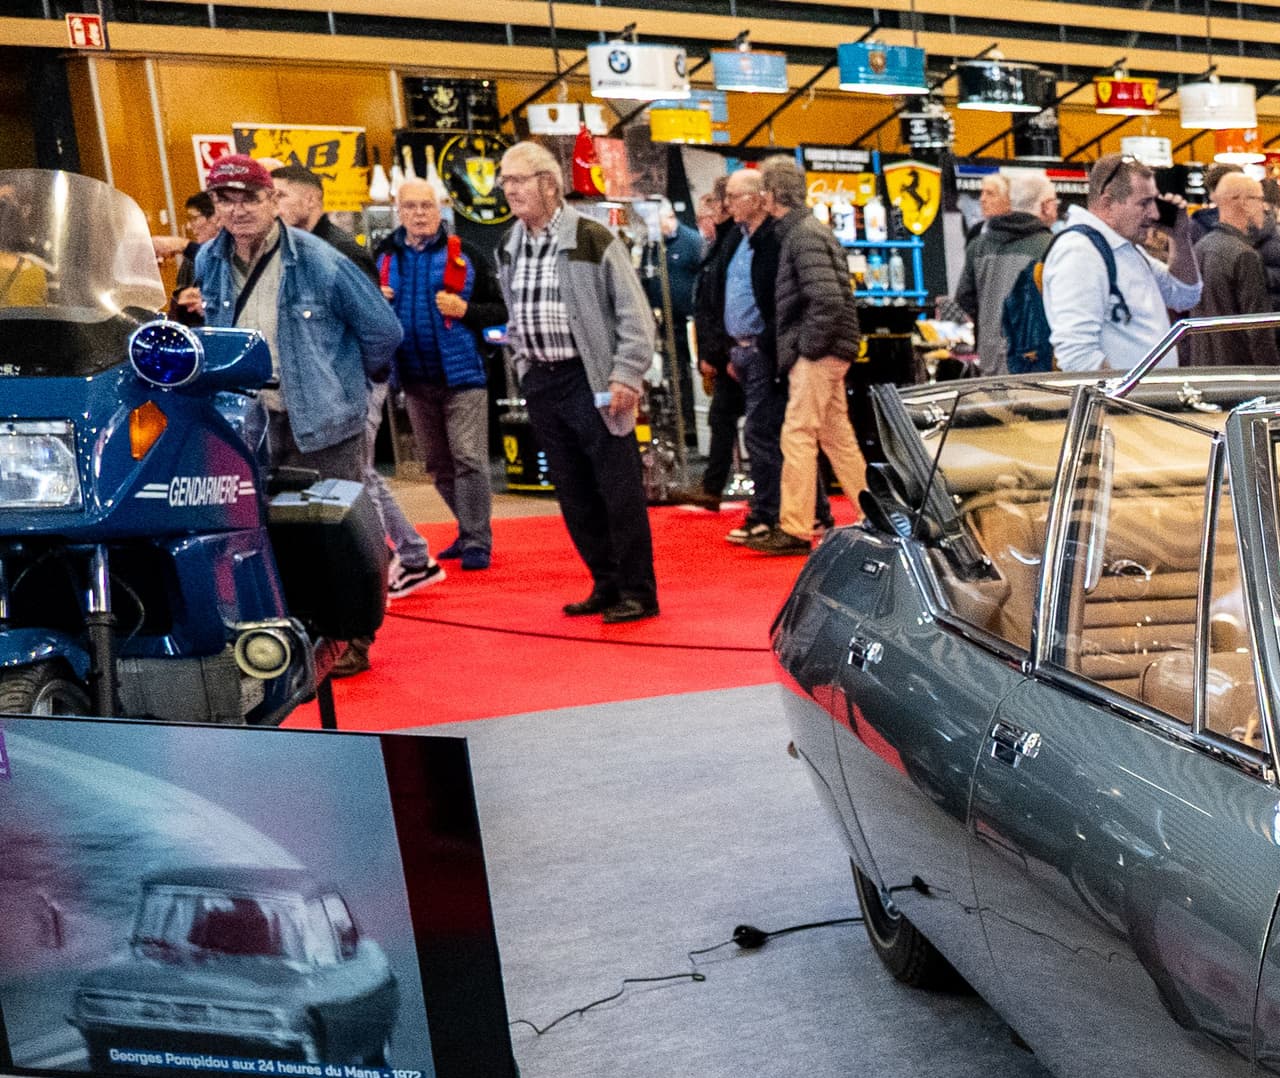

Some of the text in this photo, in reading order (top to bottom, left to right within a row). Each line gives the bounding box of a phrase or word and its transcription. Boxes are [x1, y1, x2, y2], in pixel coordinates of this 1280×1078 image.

[168, 475, 240, 507] GENDARMERIE
[109, 1049, 163, 1065] Georges
[165, 1053, 229, 1071] Pompidou
[231, 1060, 256, 1071] aux
[258, 1060, 274, 1072] 24
[277, 1061, 322, 1076] heures
[325, 1065, 342, 1078] du
